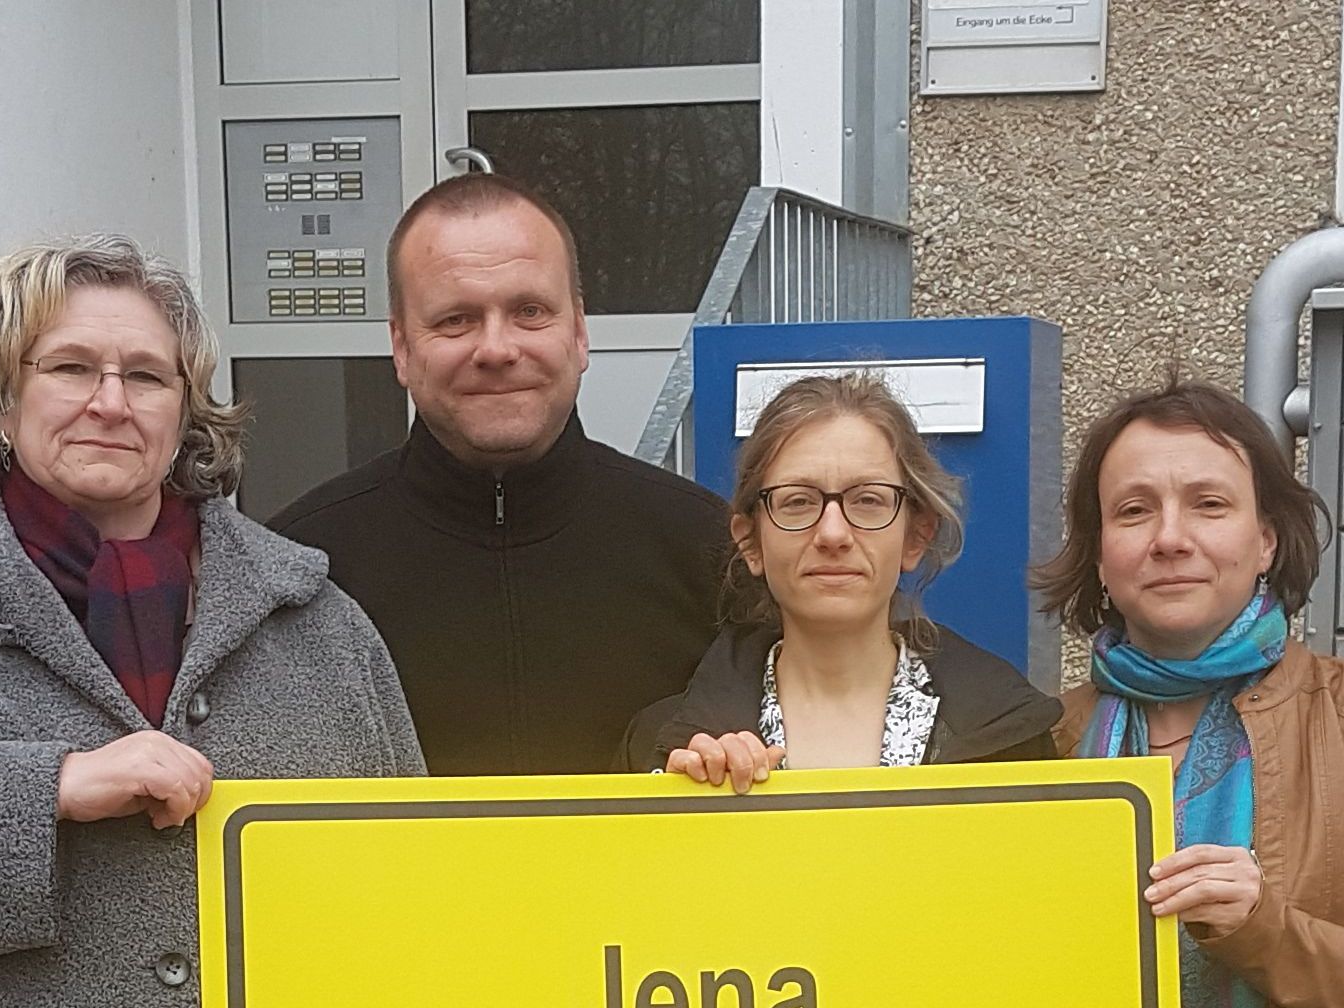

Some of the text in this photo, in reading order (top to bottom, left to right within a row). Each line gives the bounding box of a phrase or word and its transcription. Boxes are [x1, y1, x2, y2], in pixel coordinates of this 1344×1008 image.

[956, 17, 993, 28] Eingang
[1013, 15, 1026, 25] die
[1029, 15, 1052, 25] Ecke
